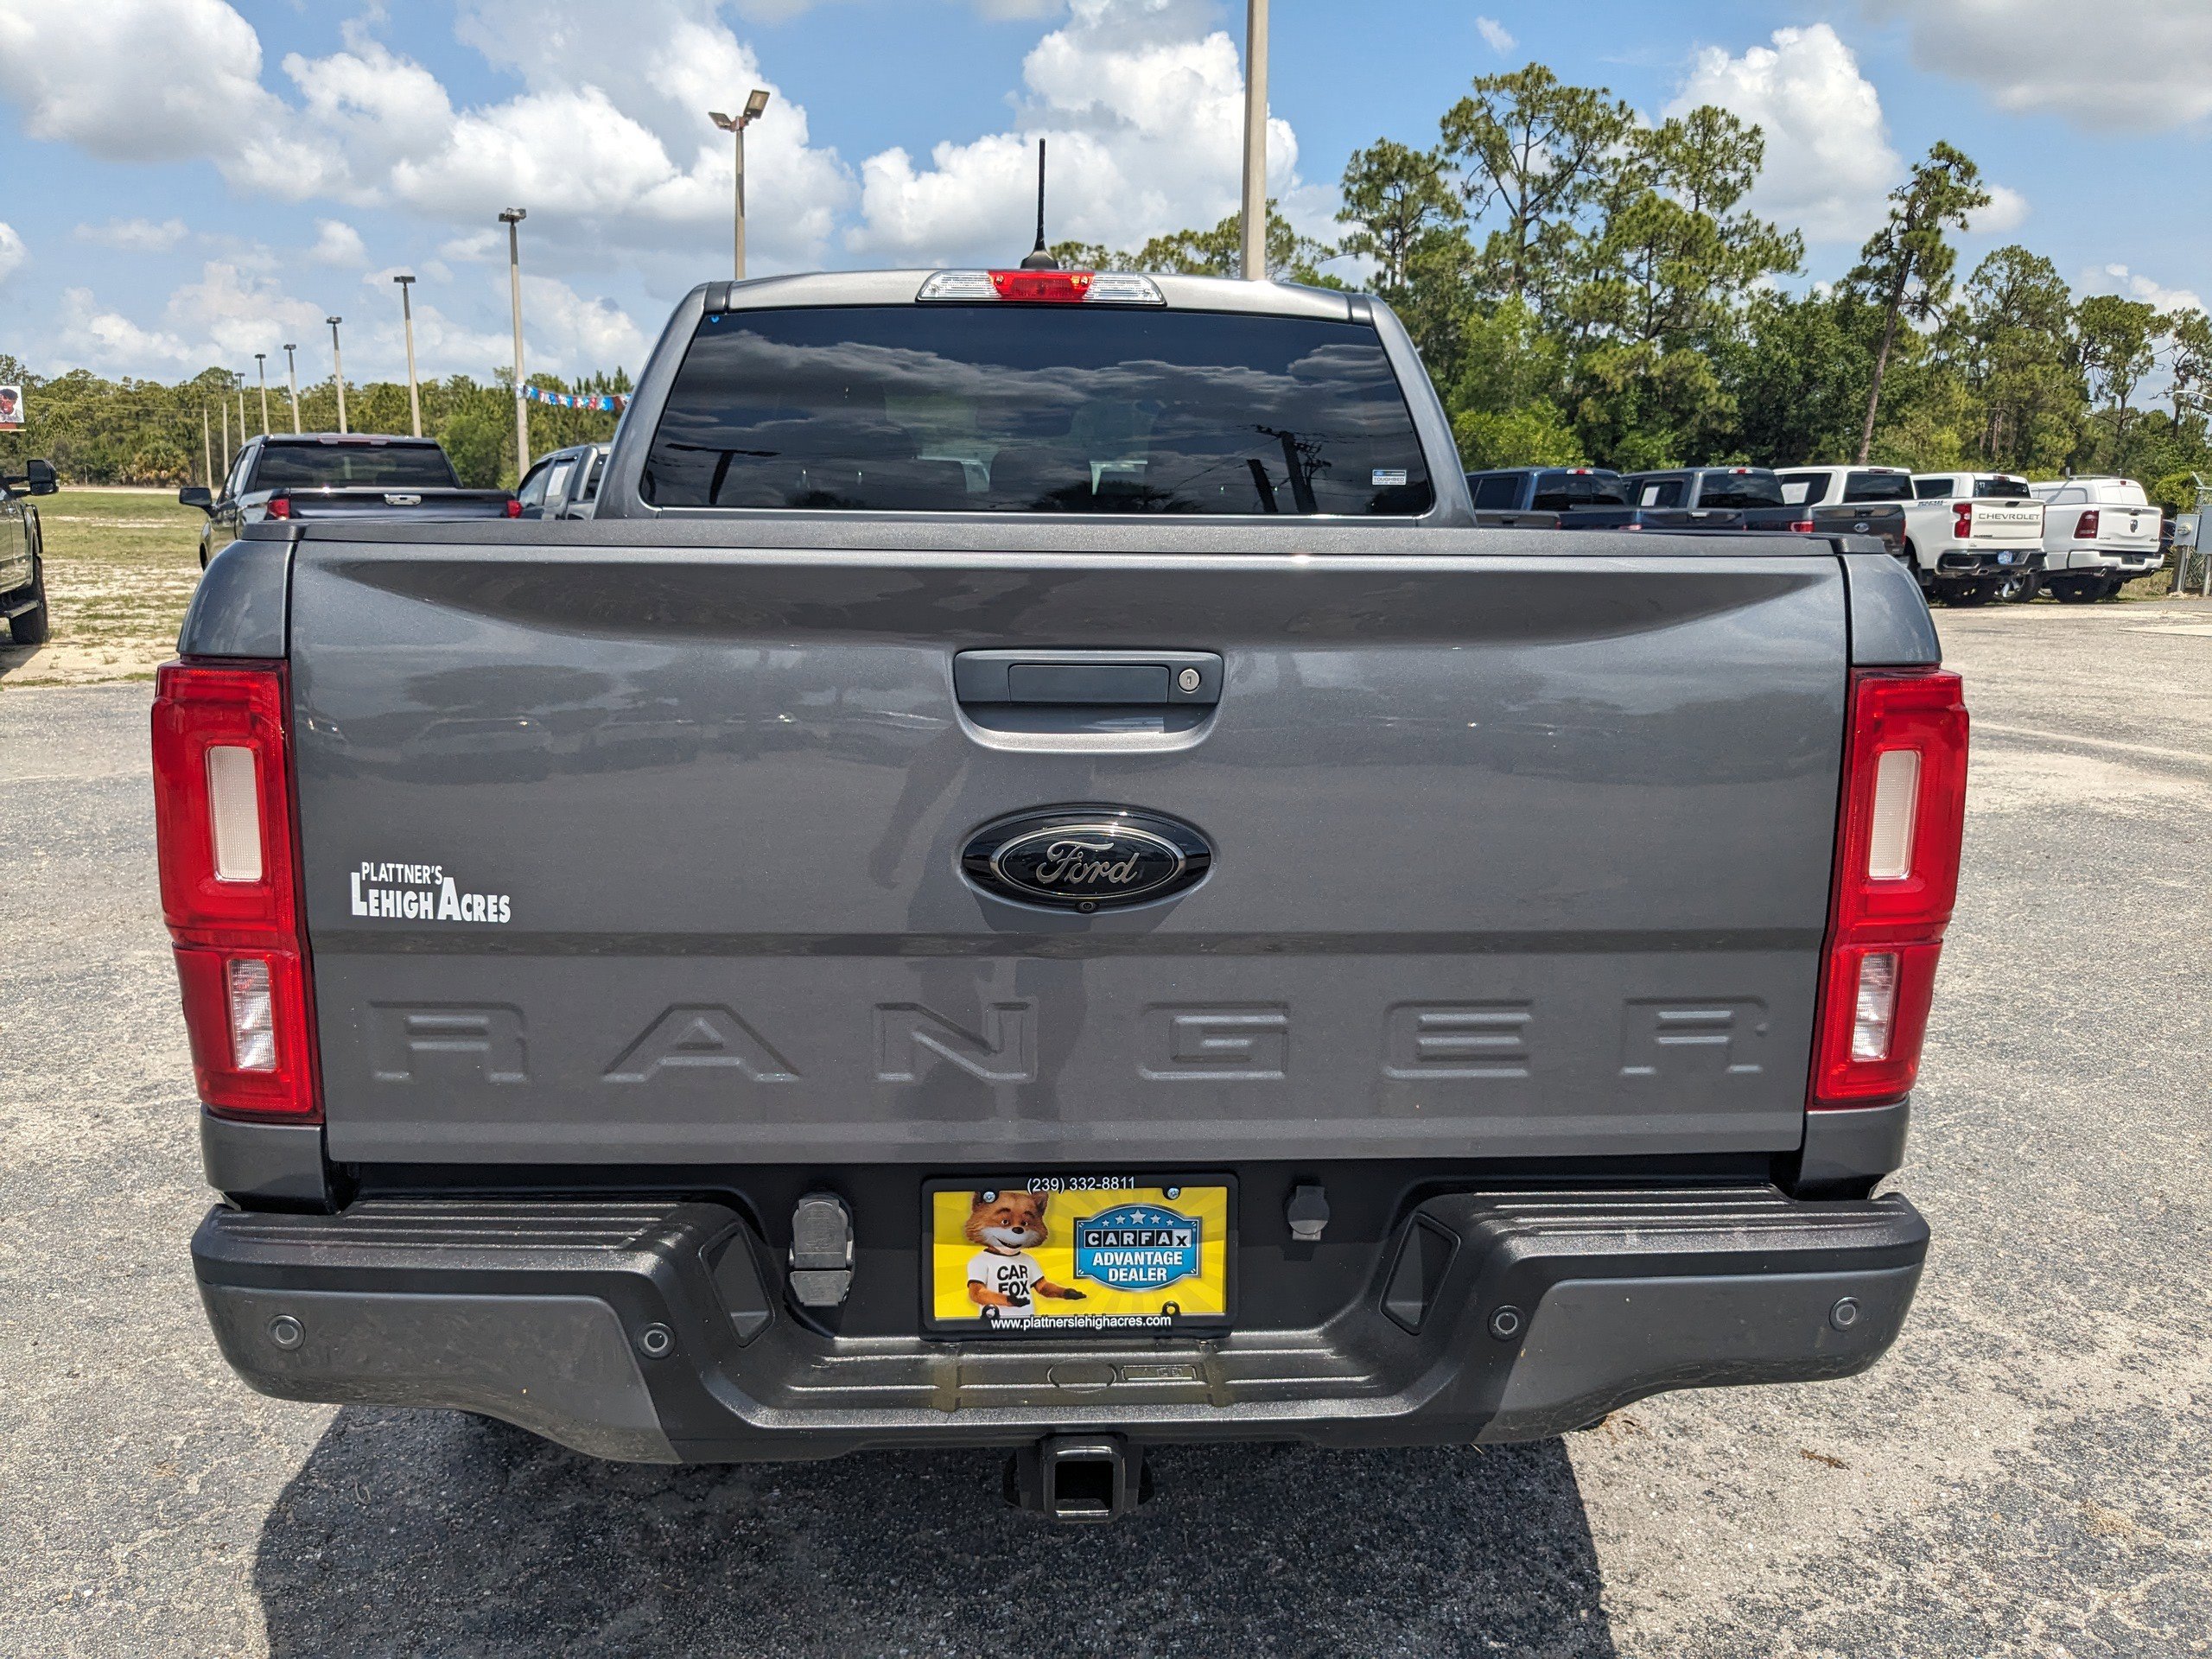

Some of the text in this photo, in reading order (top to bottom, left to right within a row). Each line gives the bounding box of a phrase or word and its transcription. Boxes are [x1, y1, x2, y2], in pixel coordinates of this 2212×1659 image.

[1036, 841, 1140, 884] Ford
[361, 861, 443, 885] PLATTNER'S
[350, 872, 512, 924] LEHIGH ACRES
[367, 996, 1770, 1085] RANGER
[1027, 1176, 1135, 1193] (239) 332-8811
[1086, 1231, 1190, 1247] CARFAX
[1092, 1251, 1183, 1266] ADVANTAGE
[996, 1264, 1028, 1281] CAR
[1108, 1267, 1167, 1282] DEALER
[998, 1280, 1030, 1296] FOX
[991, 1314, 1172, 1330] www.plattnerslehighacres.com
